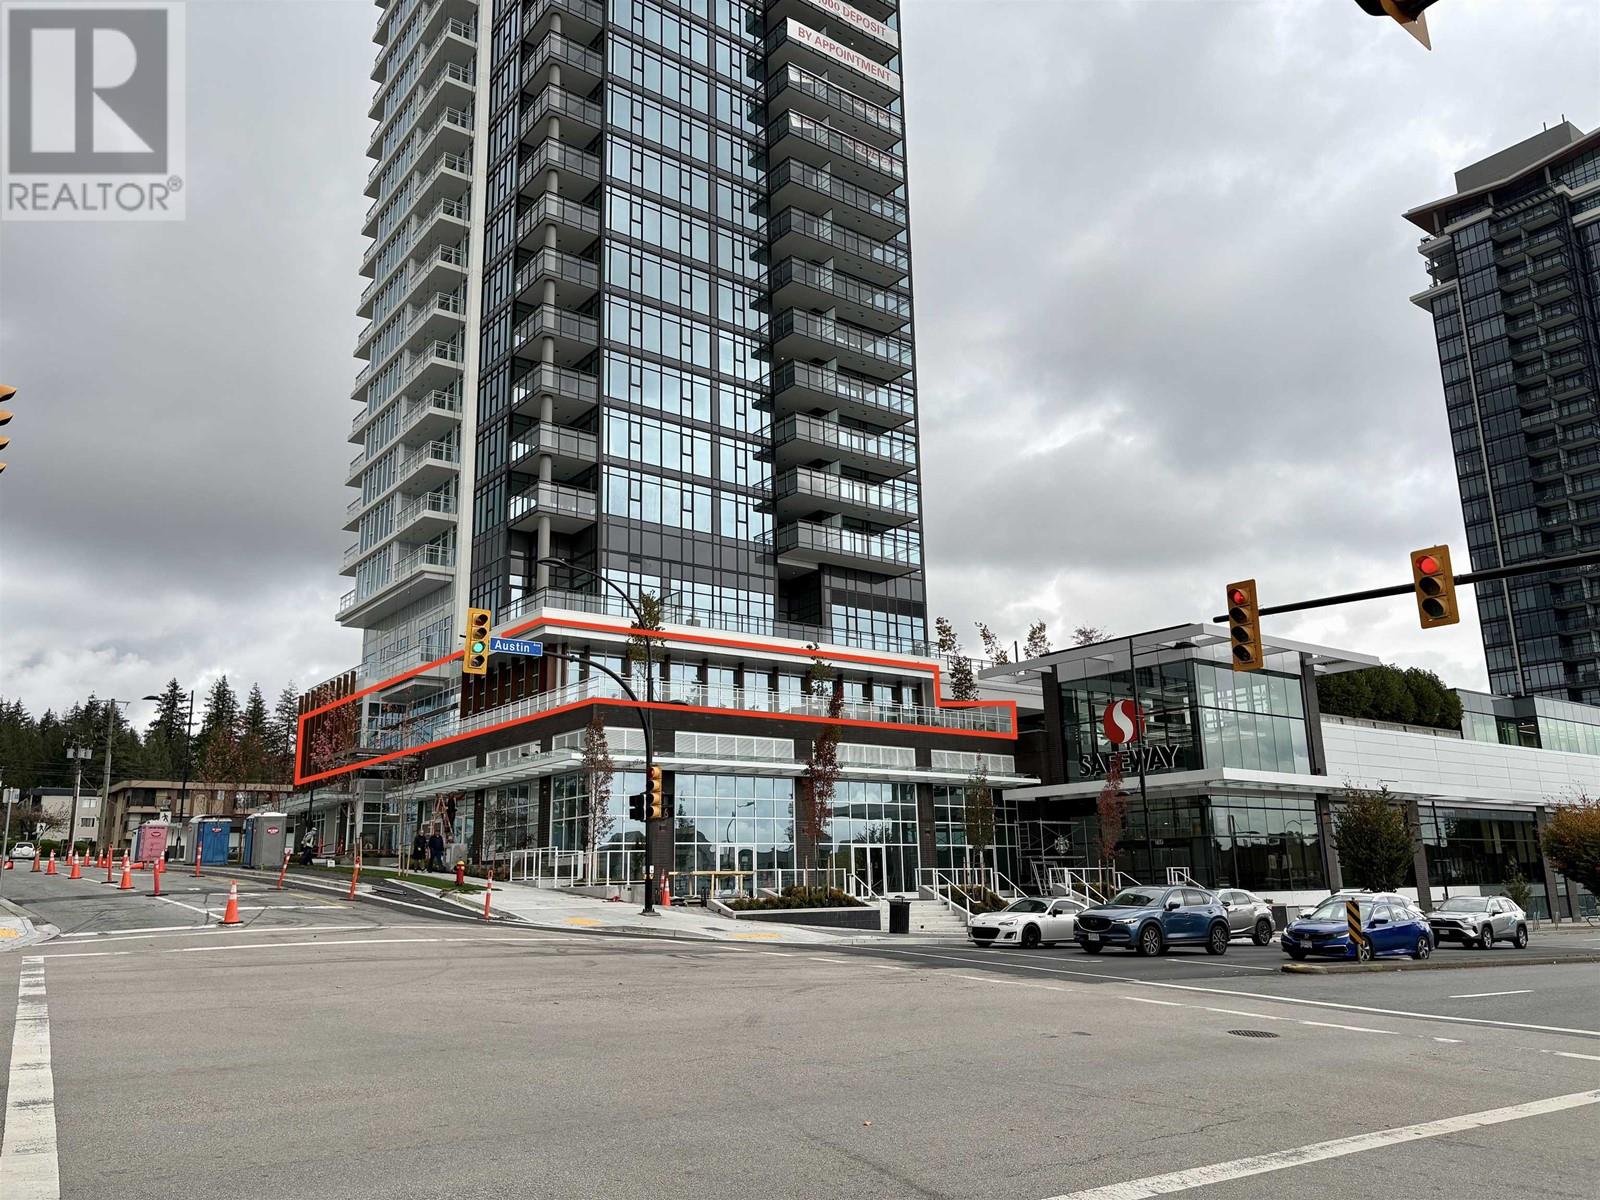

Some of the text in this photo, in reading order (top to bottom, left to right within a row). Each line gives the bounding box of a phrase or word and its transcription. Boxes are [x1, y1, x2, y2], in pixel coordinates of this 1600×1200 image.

[842, 6, 887, 36] DEPOSIT
[797, 26, 892, 81] BY APPOINTMENT
[494, 640, 530, 652] Austin
